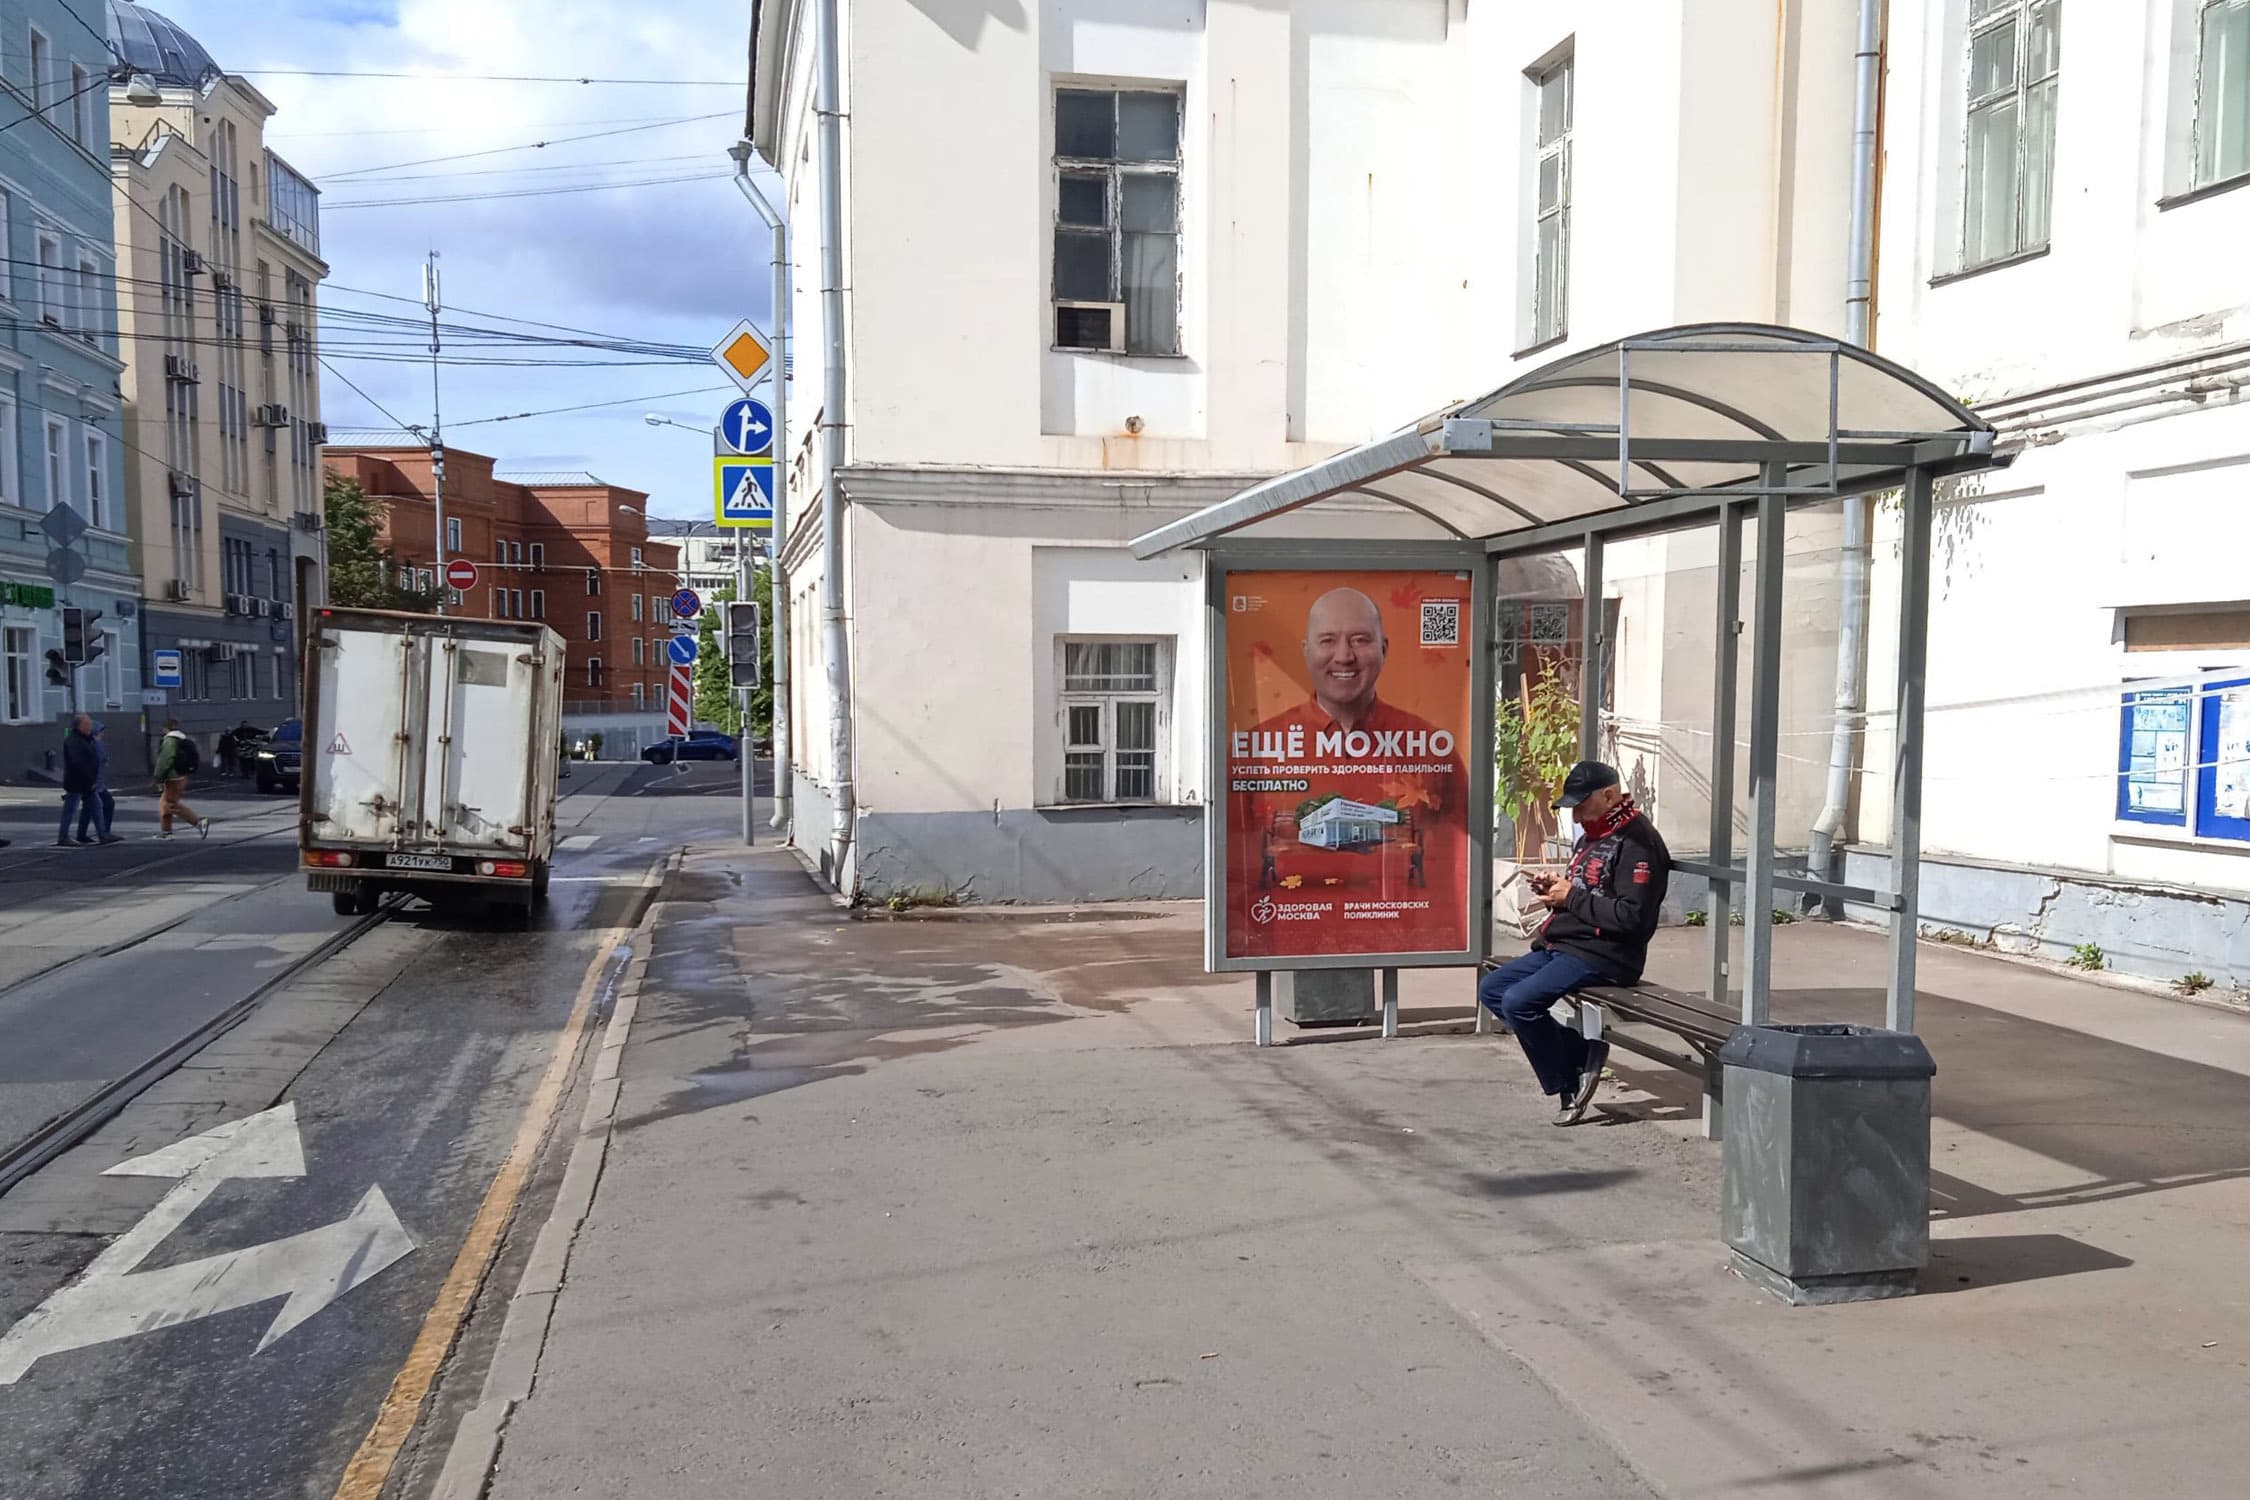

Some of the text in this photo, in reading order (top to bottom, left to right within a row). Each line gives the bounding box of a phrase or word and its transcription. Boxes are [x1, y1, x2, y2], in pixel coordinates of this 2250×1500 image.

[1231, 724, 1455, 763] ЕЩЁ МОЖНО
[1231, 763, 1454, 775] УСПЕТЬ ПРОВЕРИТЬ ЗДОРОВЬЕ В ПАВИЛЬОНЕ
[1231, 779, 1309, 792] БЕСПЛАТНО
[1277, 903, 1333, 912] ЗДОРОВАЯ
[1343, 901, 1430, 910] ВРАЧИ МОСКОВСКИХ
[1277, 912, 1321, 920] МОСКВА
[1343, 911, 1400, 919] ПОЛИКЛИНИК
